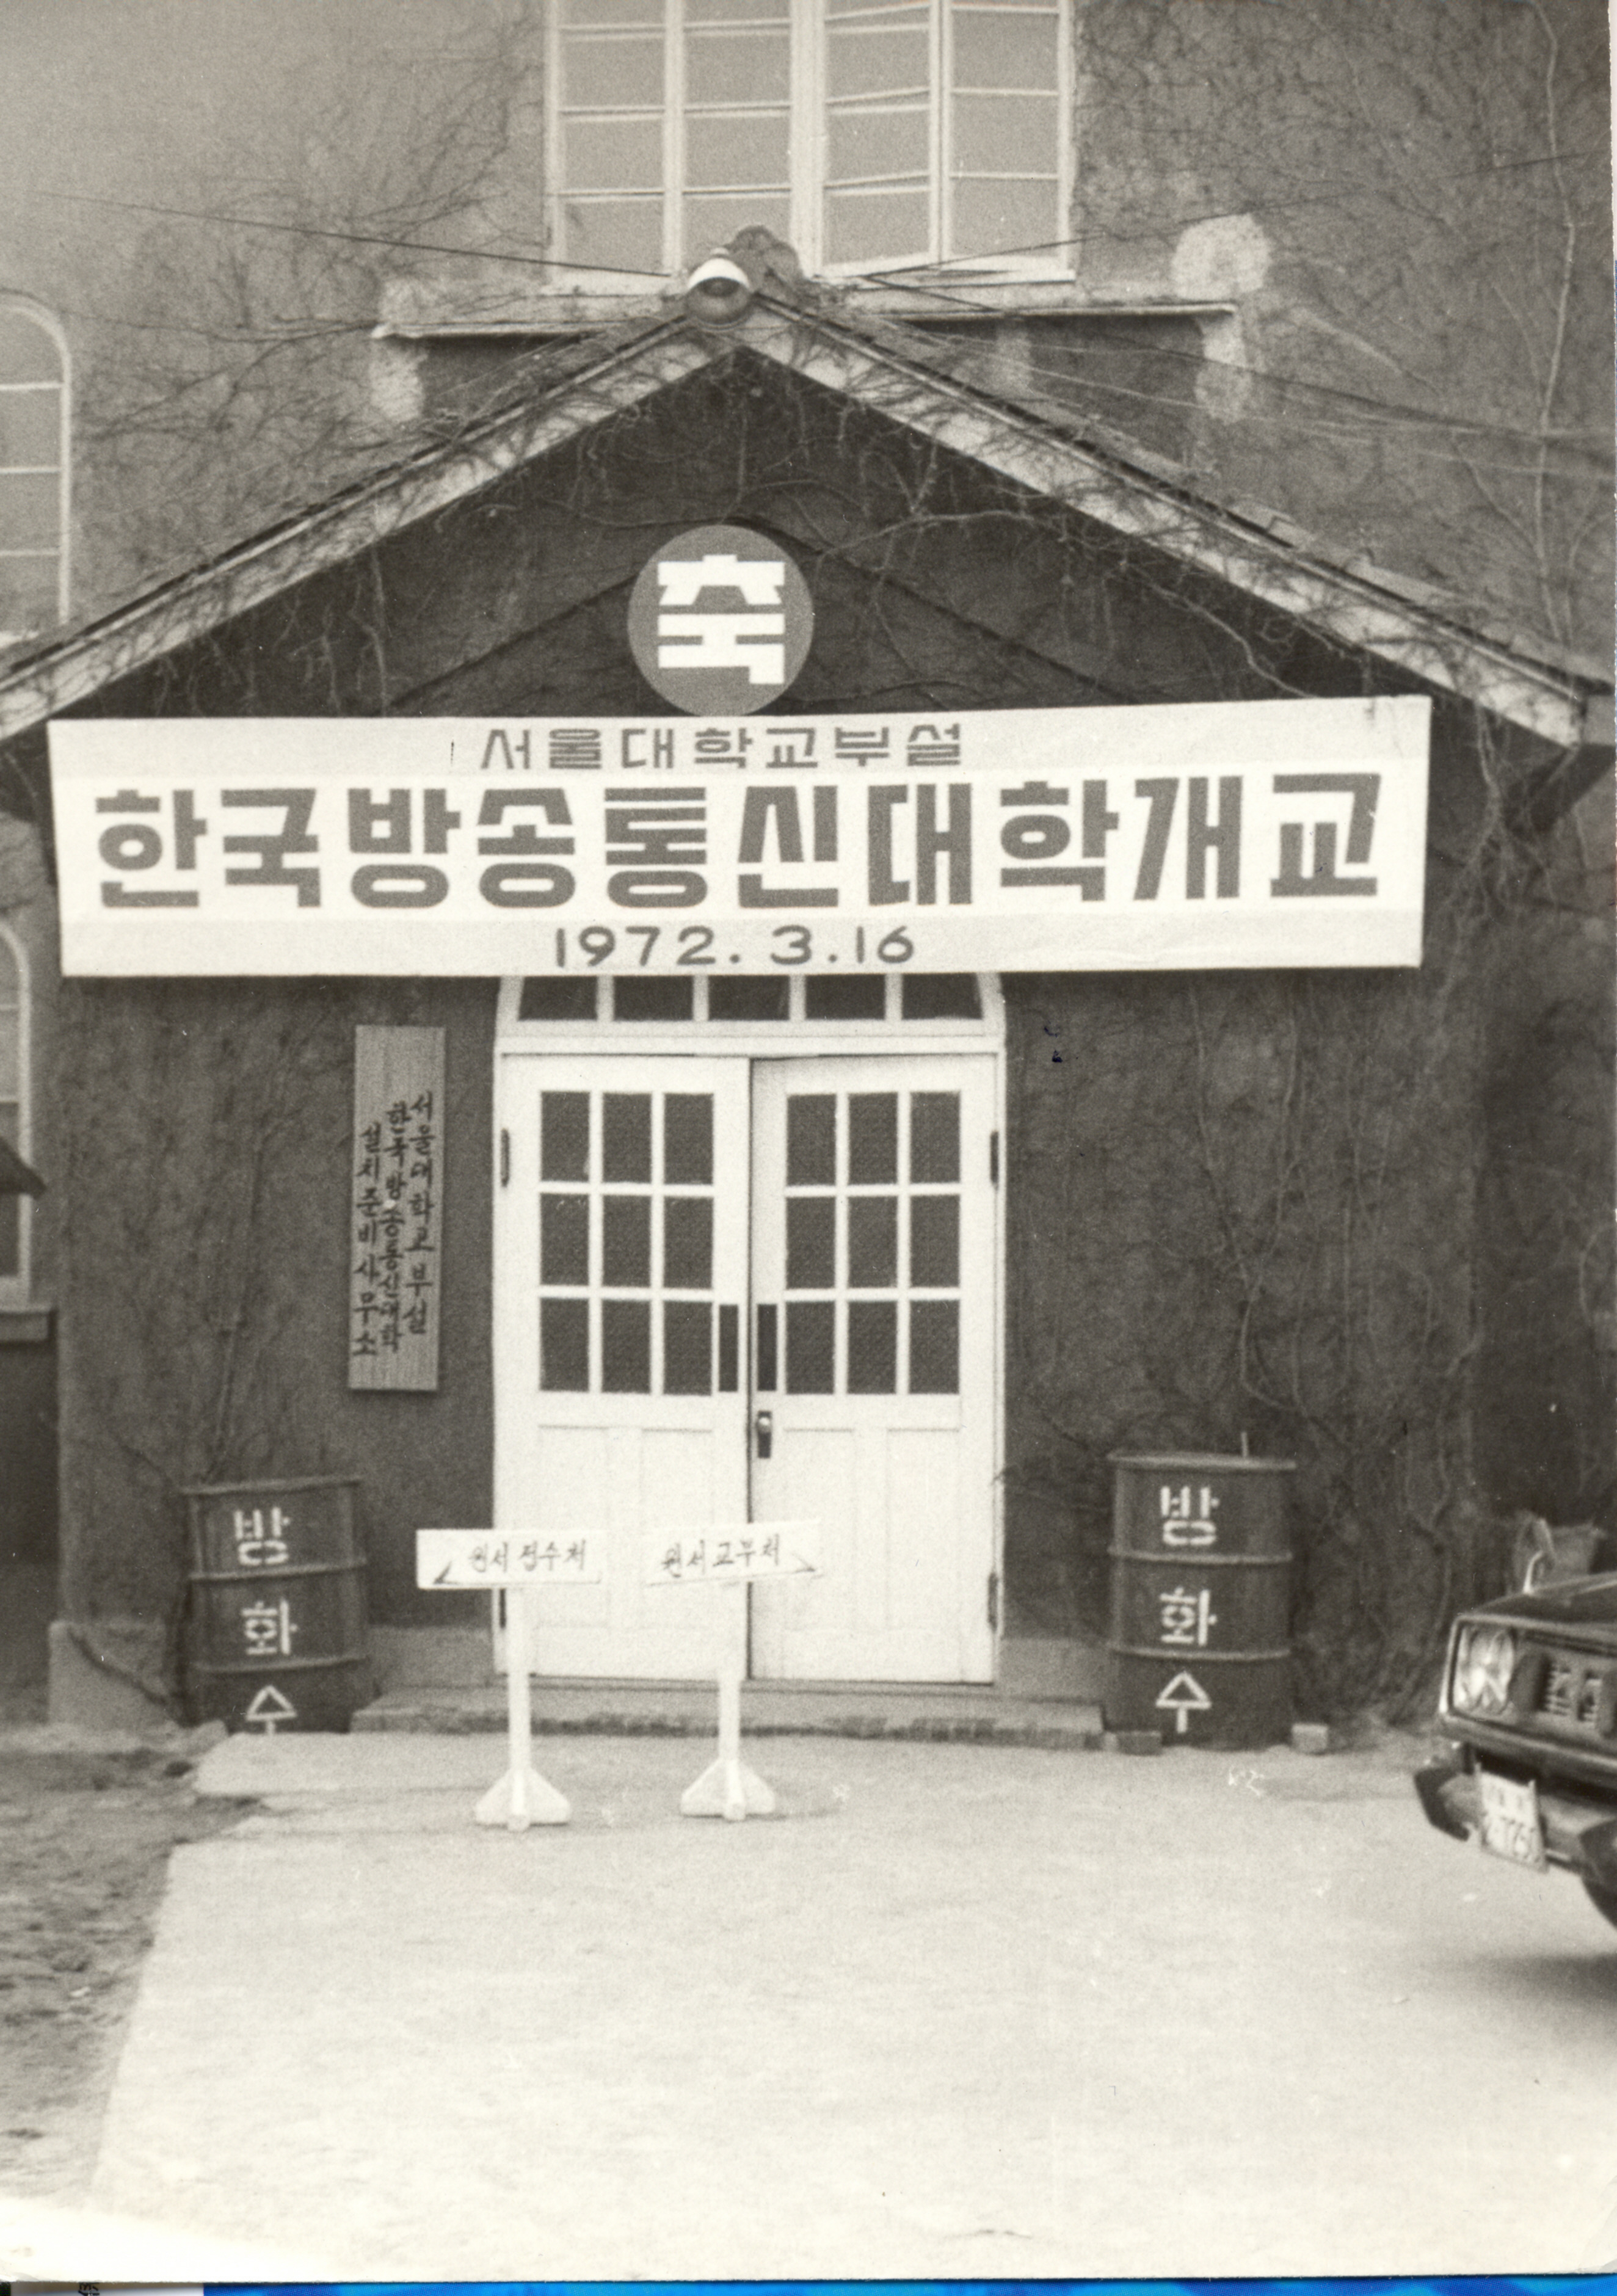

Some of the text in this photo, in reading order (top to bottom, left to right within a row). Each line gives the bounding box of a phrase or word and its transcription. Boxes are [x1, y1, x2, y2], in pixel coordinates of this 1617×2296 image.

[657, 554, 785, 685] 축
[480, 723, 962, 771] 서울대학교부설
[95, 773, 1382, 909] 한국방송통신대학개교
